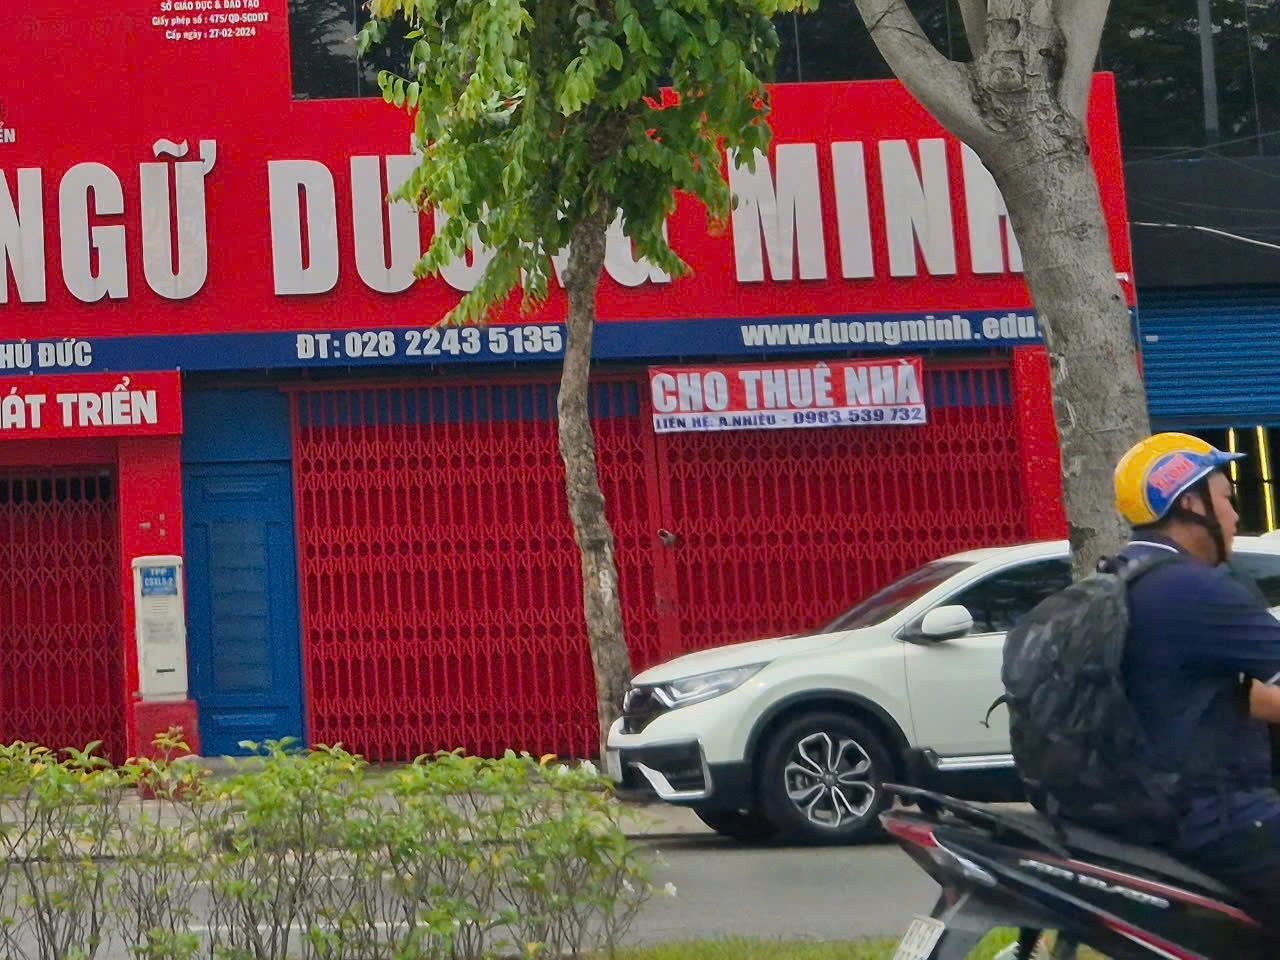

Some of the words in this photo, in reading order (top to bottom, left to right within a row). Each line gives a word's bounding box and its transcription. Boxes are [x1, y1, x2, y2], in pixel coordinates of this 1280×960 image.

[174, 0, 193, 10] GIÁO
[214, 0, 221, 9] &
[242, 0, 260, 10] TẠO
[209, 27, 256, 38] 27-02-2024
[38, 337, 93, 368] ĐỨC
[404, 326, 482, 357] 2243
[489, 324, 563, 355] 5135
[651, 371, 729, 413] CHO
[738, 360, 834, 409] THUÊ
[844, 358, 922, 406] NHÀ
[56, 375, 158, 428] TRIỂN
[793, 410, 842, 426] 0983
[848, 408, 885, 423] 539
[890, 407, 922, 422] 732
